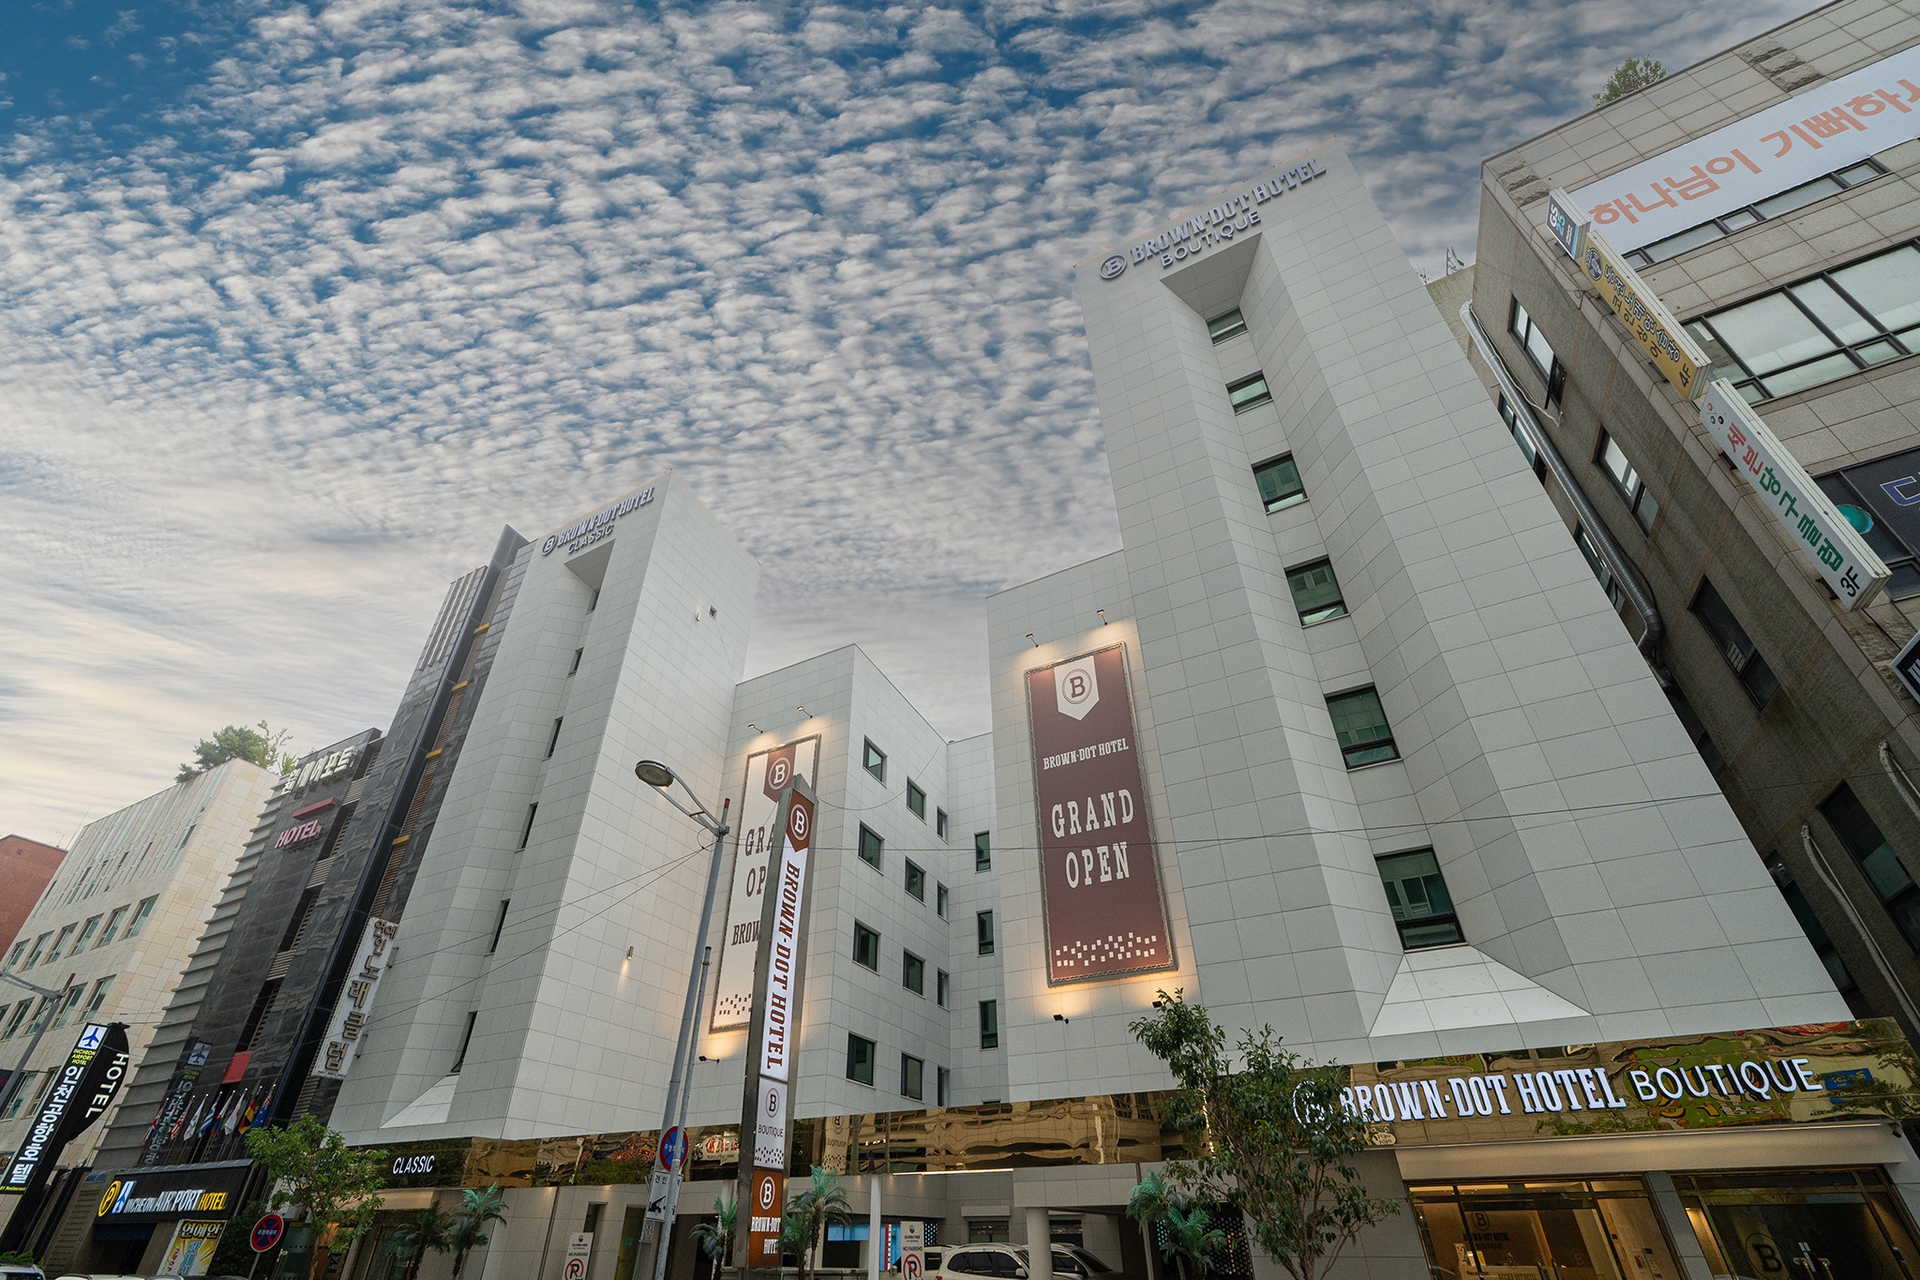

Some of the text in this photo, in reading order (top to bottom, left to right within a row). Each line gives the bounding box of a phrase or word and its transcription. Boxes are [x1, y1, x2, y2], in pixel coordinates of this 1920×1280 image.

[1252, 158, 1327, 205] HOTEL
[1588, 148, 1763, 225] 하나님이
[1549, 203, 1559, 229] GS
[1556, 211, 1566, 237] 25
[1160, 209, 1261, 269] BOUTIQUE
[1604, 263, 1681, 363] 동전노래연습장
[1612, 295, 1662, 358] 코인싱어
[1679, 363, 1692, 389] 4F
[619, 487, 655, 517] HOTEL
[567, 523, 614, 554] CLASSIC
[1840, 565, 1861, 598] 3F
[1070, 675, 1086, 698] B
[1098, 738, 1129, 757] HOTEL
[774, 763, 786, 784] B
[794, 810, 805, 834] B
[1052, 788, 1134, 838] GRAND
[274, 819, 319, 849] HOTEL
[745, 823, 775, 857] GRA
[1066, 841, 1130, 888] OPEN
[746, 865, 767, 897] OP
[731, 920, 760, 946] BROW
[325, 955, 381, 1072] 노래클럽
[766, 992, 788, 1070] HOTEL
[73, 1049, 97, 1057] INCHEON
[85, 1052, 129, 1119] HOTEL
[1513, 1067, 1627, 1115] HOTEL
[1629, 1058, 1823, 1101] BOUTIQUE
[768, 1094, 777, 1113] B
[9, 1065, 84, 1184] 인천공항호텔
[757, 1123, 784, 1138] BOUTIQUE
[392, 1155, 435, 1175] CLASSIC
[124, 1198, 156, 1214] INCHEON
[197, 1192, 228, 1211] HOTEL
[763, 1183, 773, 1204] B
[763, 1238, 779, 1255] HOTE
